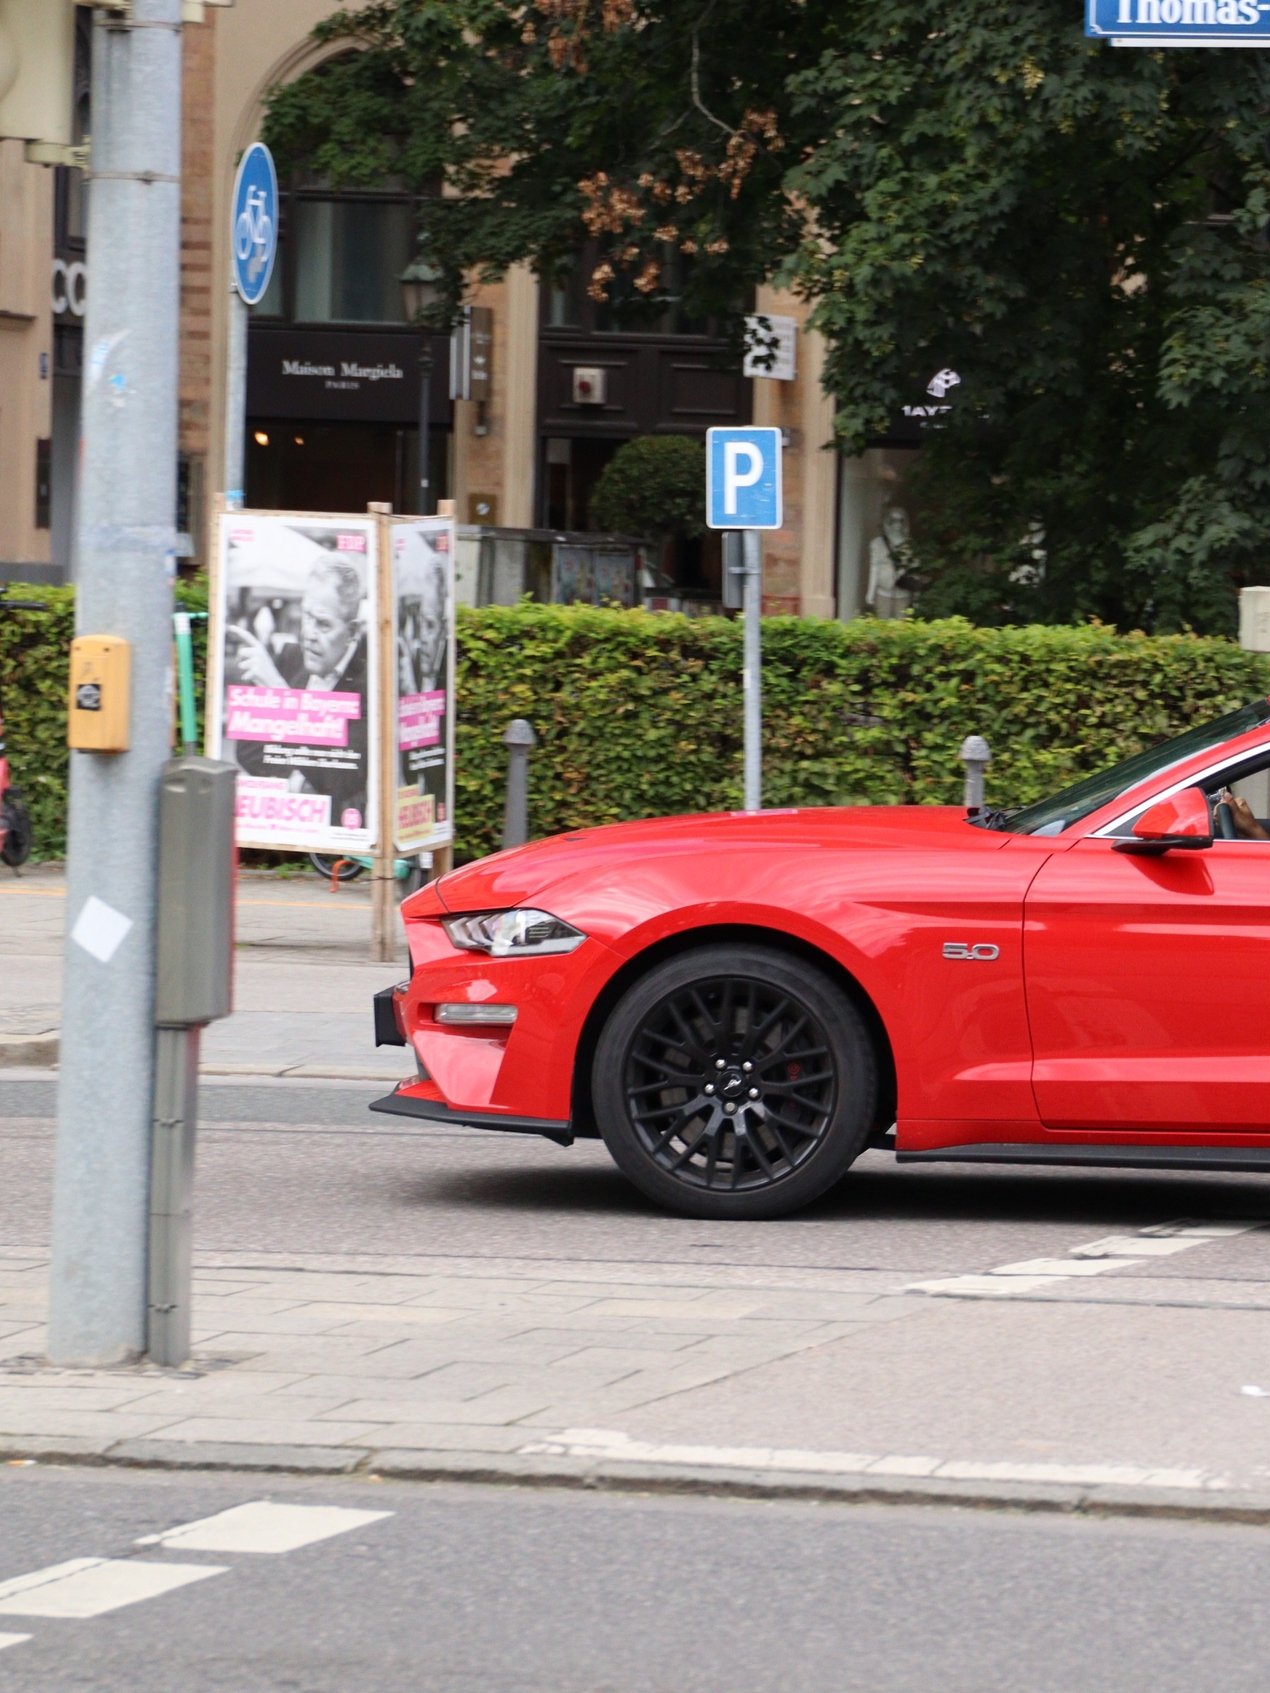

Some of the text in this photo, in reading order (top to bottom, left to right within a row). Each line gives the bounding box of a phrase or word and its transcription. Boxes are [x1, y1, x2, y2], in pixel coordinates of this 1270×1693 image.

[282, 361, 403, 381] Maison Margiela
[724, 441, 763, 515] P
[230, 688, 280, 709] Schule
[284, 691, 297, 710] in
[230, 710, 343, 741] Mangelhaft!
[942, 942, 999, 960] 5.0
